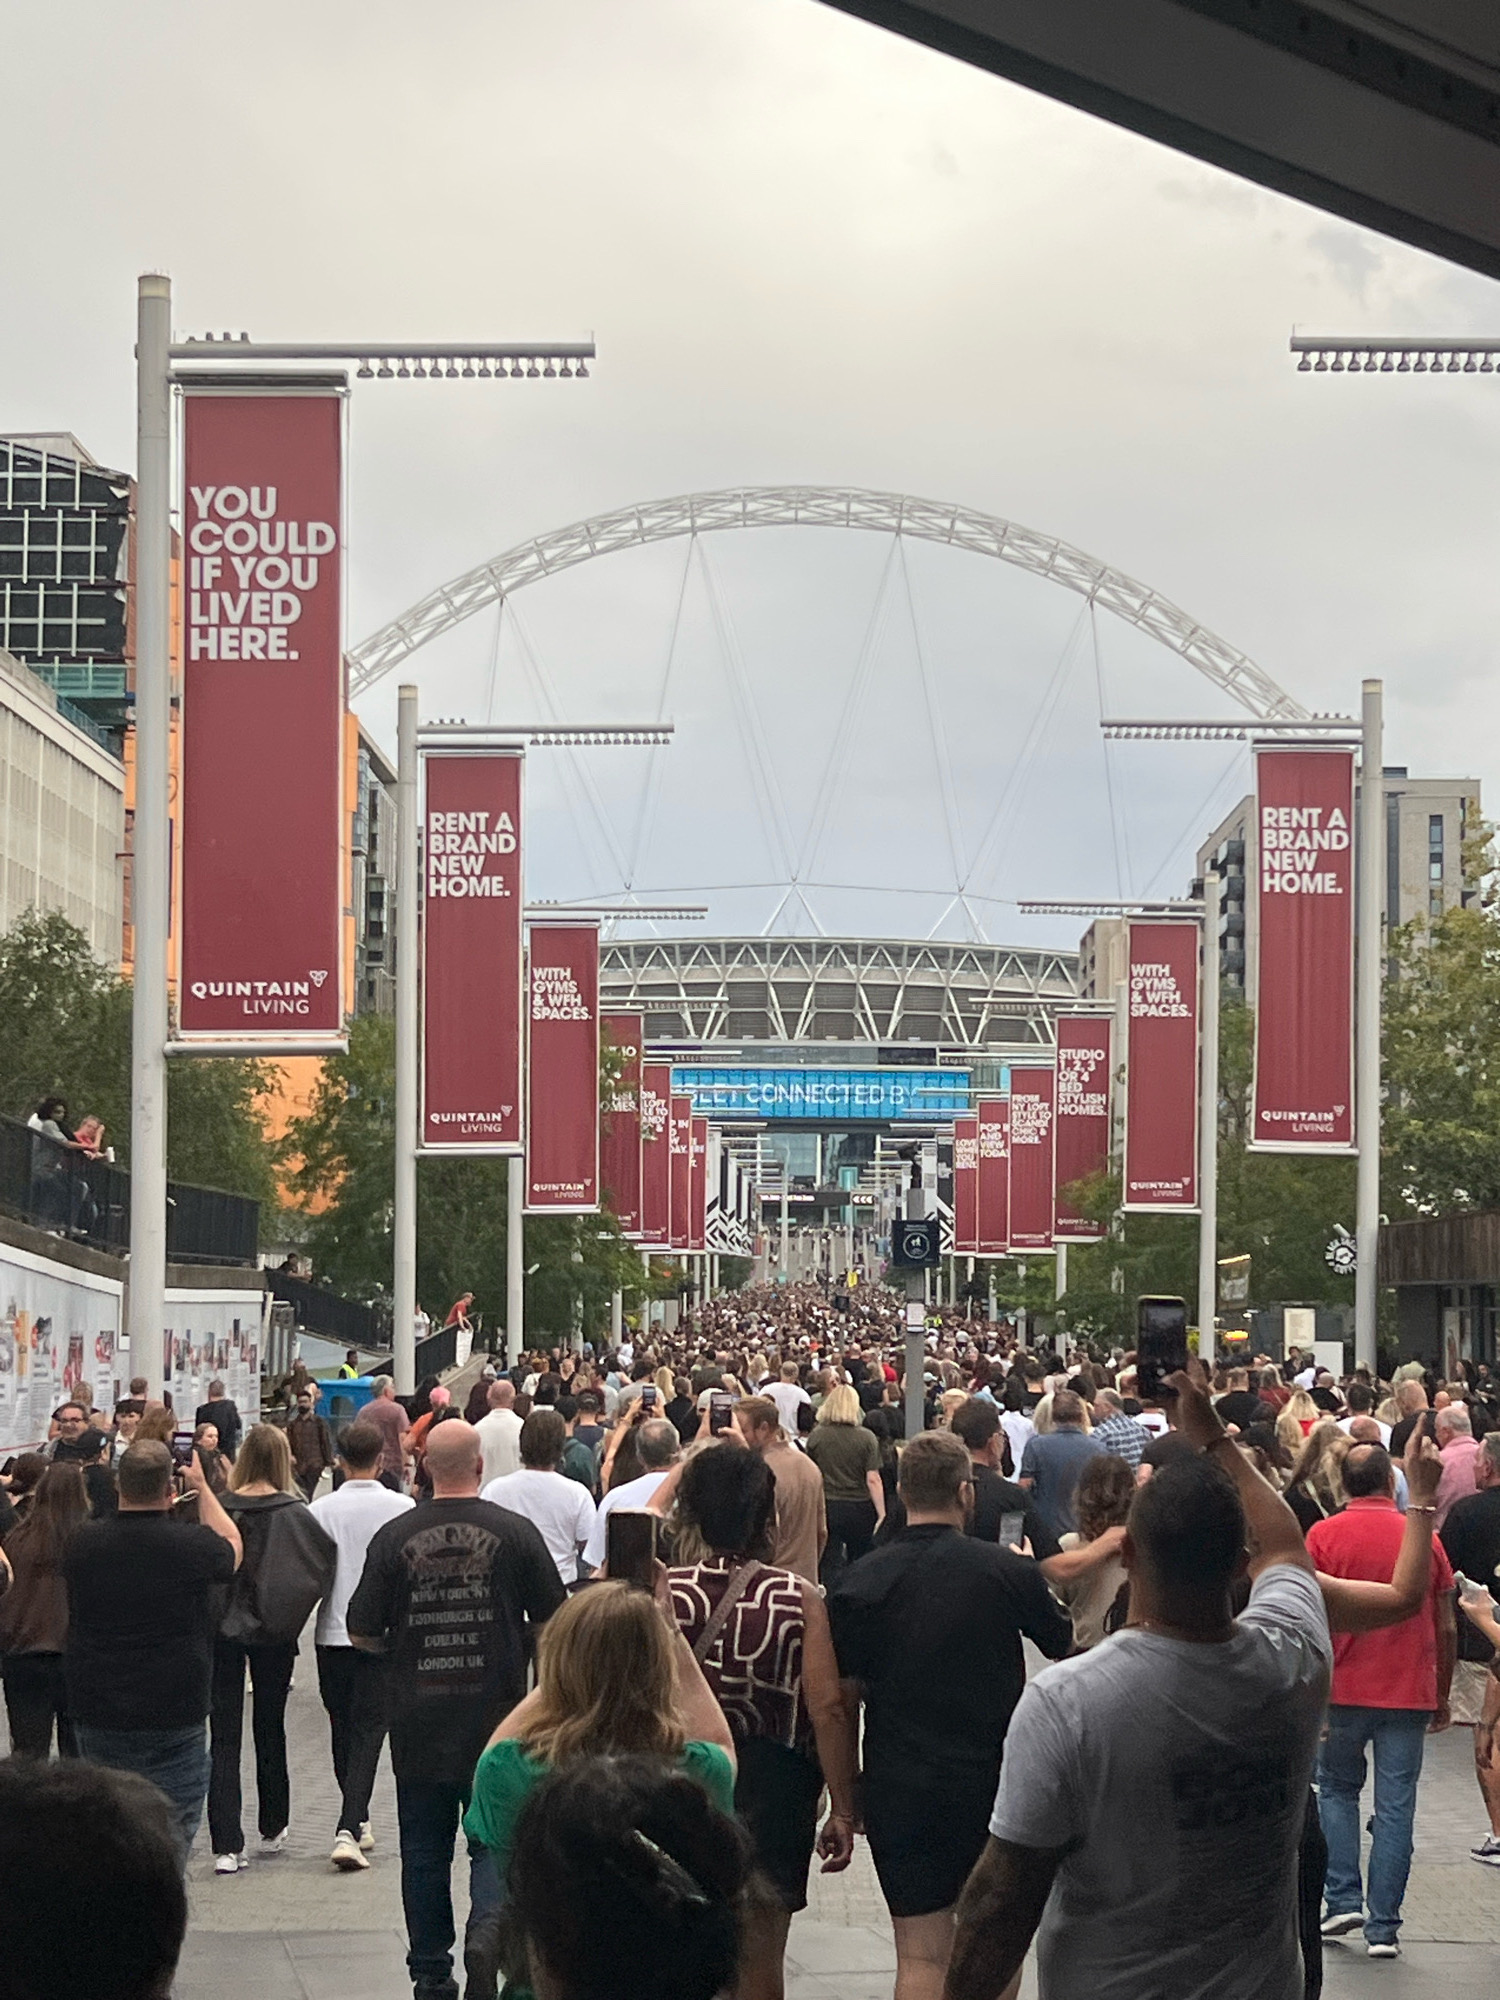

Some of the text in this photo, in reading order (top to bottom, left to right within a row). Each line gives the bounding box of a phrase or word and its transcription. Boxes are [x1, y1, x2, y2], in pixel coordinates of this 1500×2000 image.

[190, 485, 277, 520] YOU
[190, 520, 336, 555] COULD
[190, 556, 318, 591] IF YOU
[190, 591, 302, 625] LIVED
[190, 626, 299, 661] HERE.
[429, 811, 514, 833] RENT A
[1262, 806, 1347, 829] RENT A
[429, 833, 517, 854] BRAND
[1262, 828, 1349, 851] BRAND
[429, 854, 485, 876] NEW
[1262, 850, 1318, 872] NEW
[429, 875, 511, 898] HOME.
[1263, 871, 1343, 894] HOME.
[531, 967, 571, 981] WITH
[1131, 963, 1170, 977] WITH
[191, 981, 309, 998] QUINTAIN
[532, 980, 578, 994] GYMS
[1130, 977, 1177, 991] GYMS
[532, 993, 582, 1007] & WFH
[1131, 990, 1181, 1004] & WFH
[243, 999, 310, 1014] LIVING
[532, 1005, 593, 1020] SPACES.
[1130, 1003, 1193, 1017] SPACES.
[1058, 1049, 1105, 1060] STUDIO
[1058, 1071, 1078, 1082] OR
[745, 1083, 887, 1105] CONNECTED
[1058, 1082, 1083, 1093] BED
[1058, 1092, 1107, 1105] STYLISH
[1058, 1104, 1108, 1116] HOMES.
[1261, 1110, 1334, 1122] QUINTAIN
[430, 1112, 502, 1125] QUINTAIN
[461, 1123, 502, 1134] LIVING
[1292, 1122, 1335, 1133] LIVING
[532, 1183, 586, 1192] QUINTAIN
